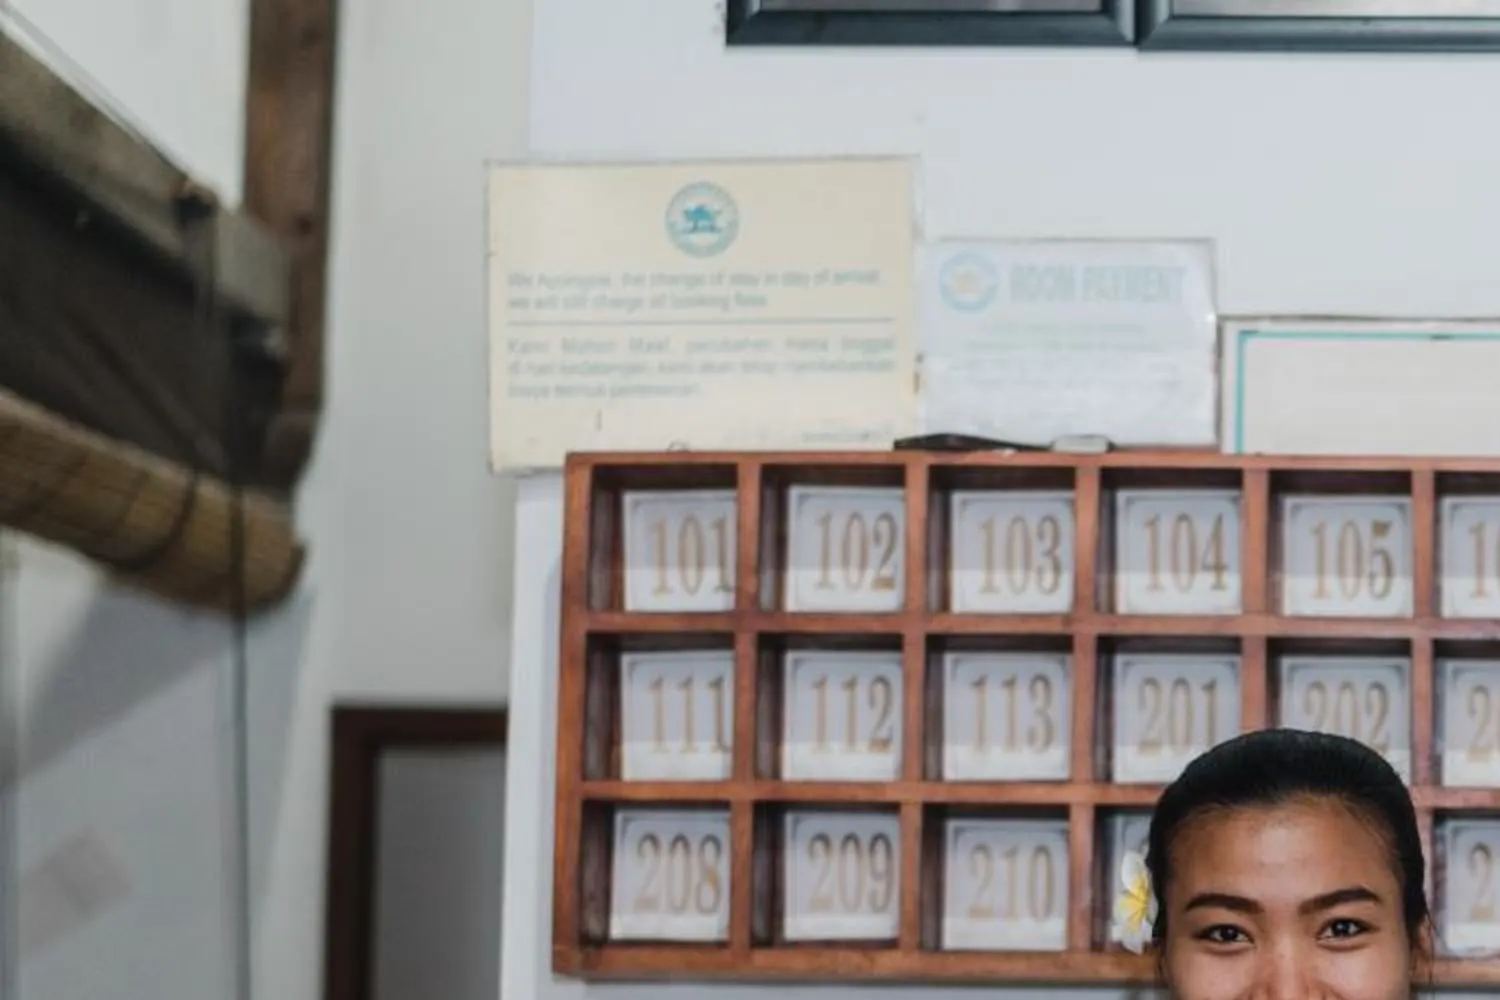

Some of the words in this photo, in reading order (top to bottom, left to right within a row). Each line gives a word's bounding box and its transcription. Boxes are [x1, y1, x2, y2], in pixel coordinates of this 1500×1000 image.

[653, 510, 735, 596] 101
[814, 511, 897, 592] 102
[977, 513, 1064, 596] 103
[1142, 513, 1229, 593] 104
[1309, 518, 1395, 602] 105
[647, 675, 733, 754] 111
[810, 674, 894, 754] 112
[970, 674, 1059, 755] 113
[1136, 676, 1220, 760] 201
[632, 832, 723, 916] 208
[806, 831, 894, 915] 209
[969, 841, 1053, 921] 210
